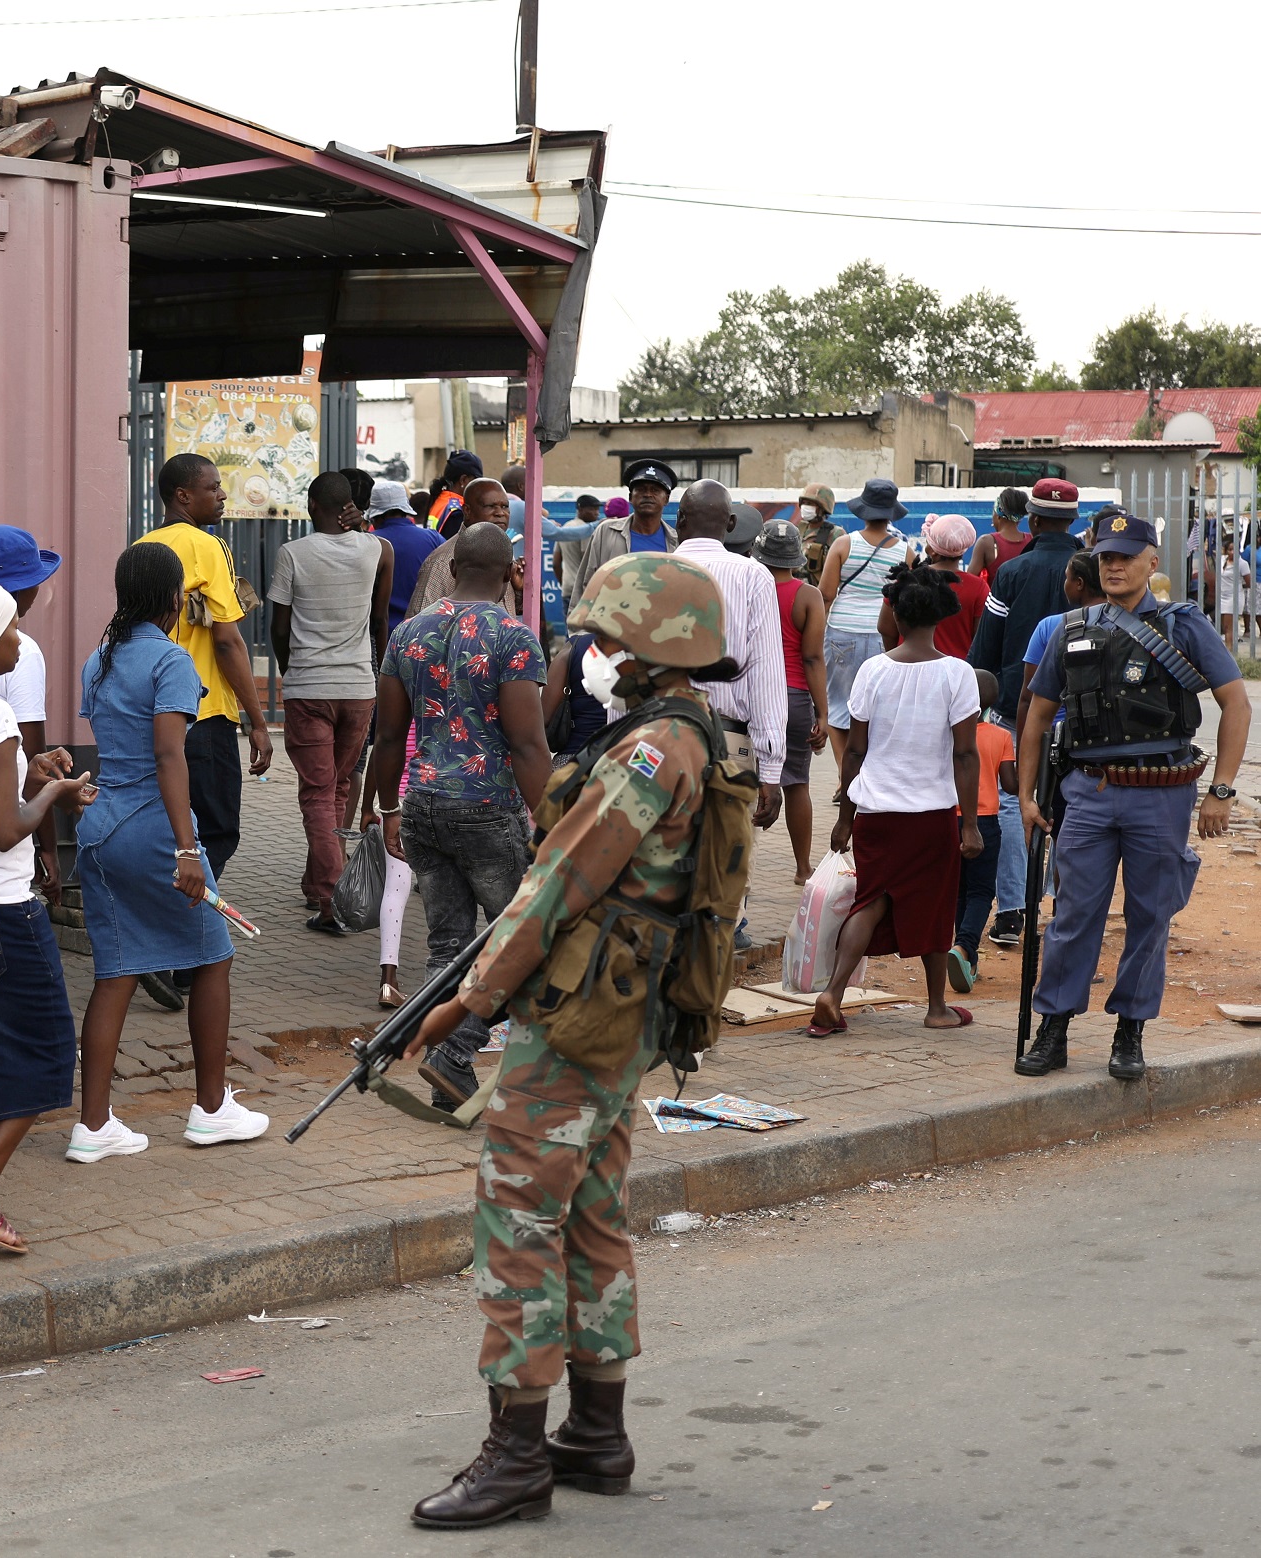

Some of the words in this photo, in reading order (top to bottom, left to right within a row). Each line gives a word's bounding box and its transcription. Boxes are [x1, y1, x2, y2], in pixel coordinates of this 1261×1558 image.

[210, 382, 244, 391] SHOP
[221, 391, 247, 401] 084
[251, 392, 274, 402] 711
